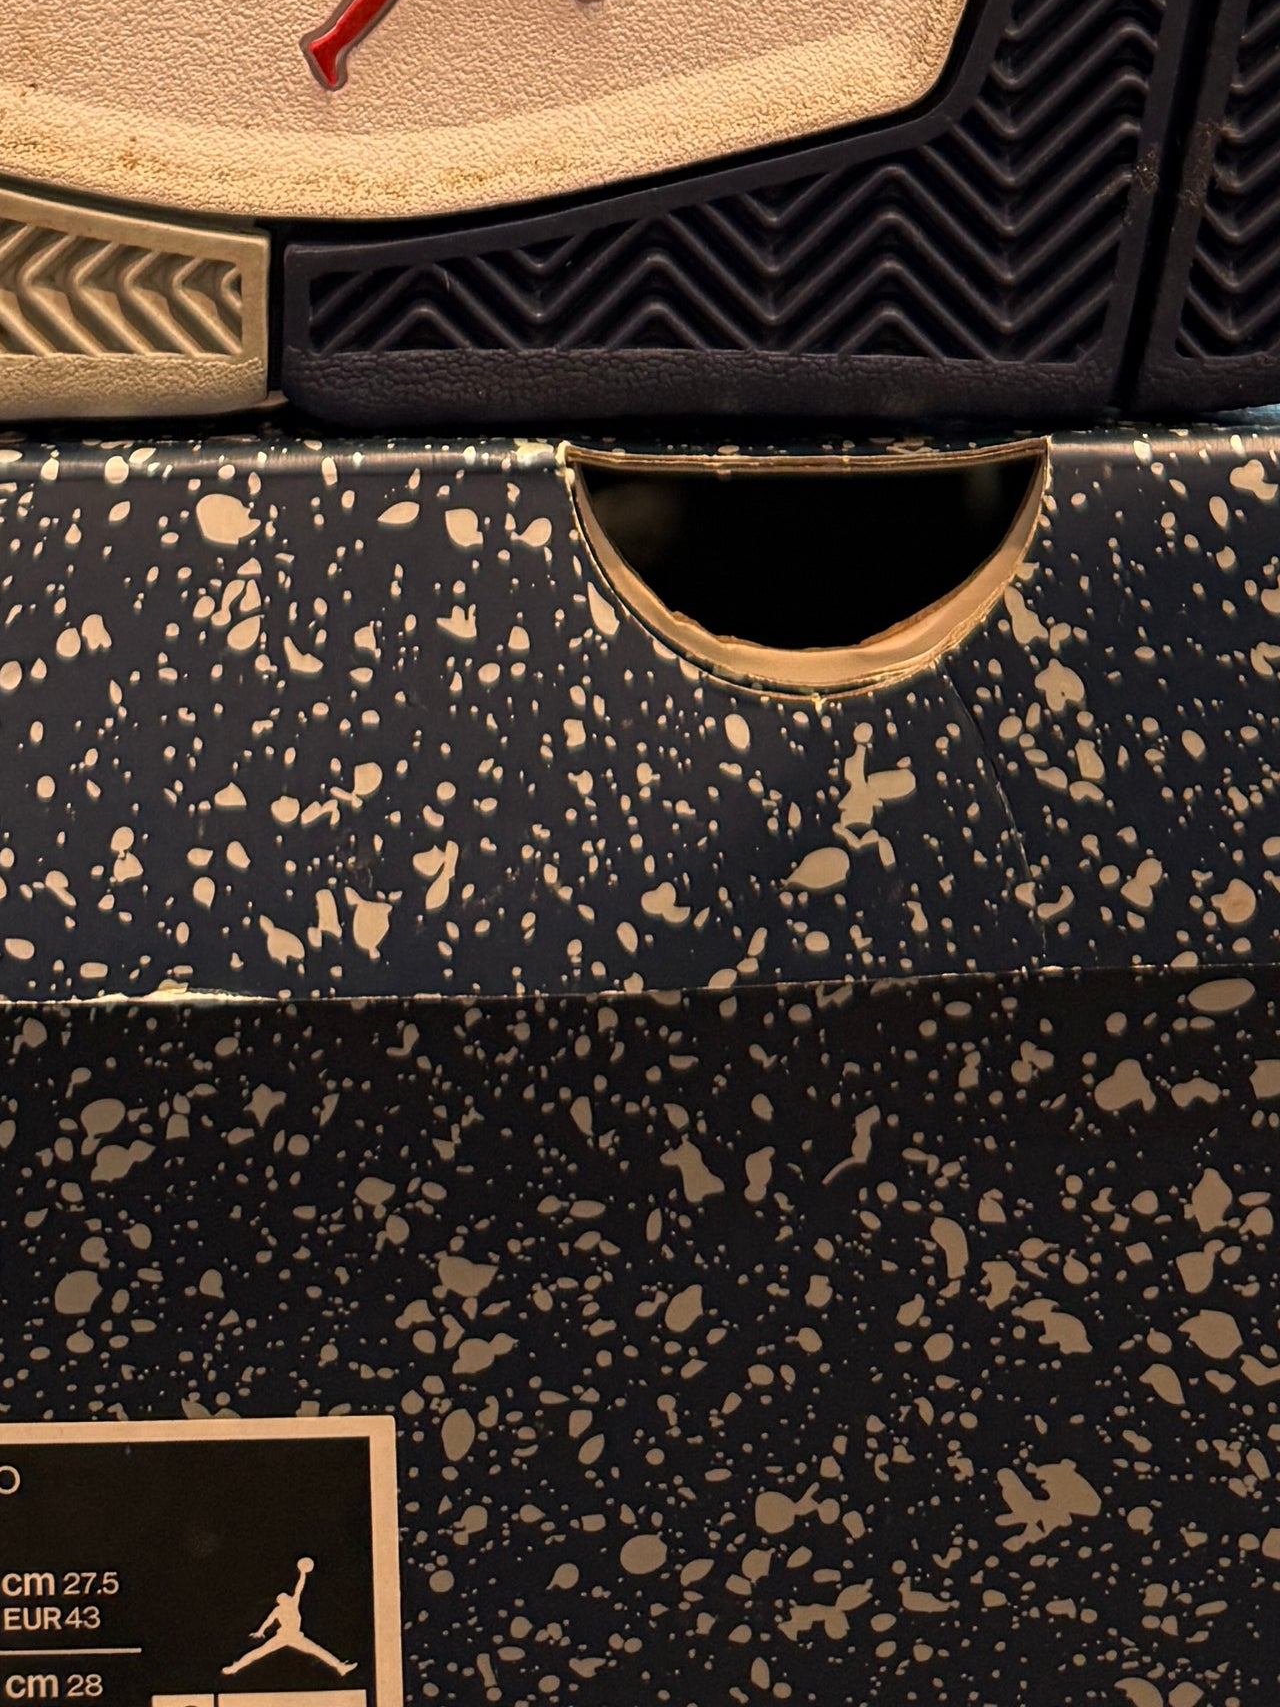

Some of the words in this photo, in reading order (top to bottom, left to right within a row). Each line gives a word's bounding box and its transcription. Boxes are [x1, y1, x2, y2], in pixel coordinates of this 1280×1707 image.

[2, 1573, 56, 1597] cm
[63, 1572, 120, 1595] 27.5
[3, 1607, 62, 1631] EUR
[64, 1606, 102, 1629] 43
[5, 1675, 59, 1698] cm
[66, 1673, 104, 1697] 28
